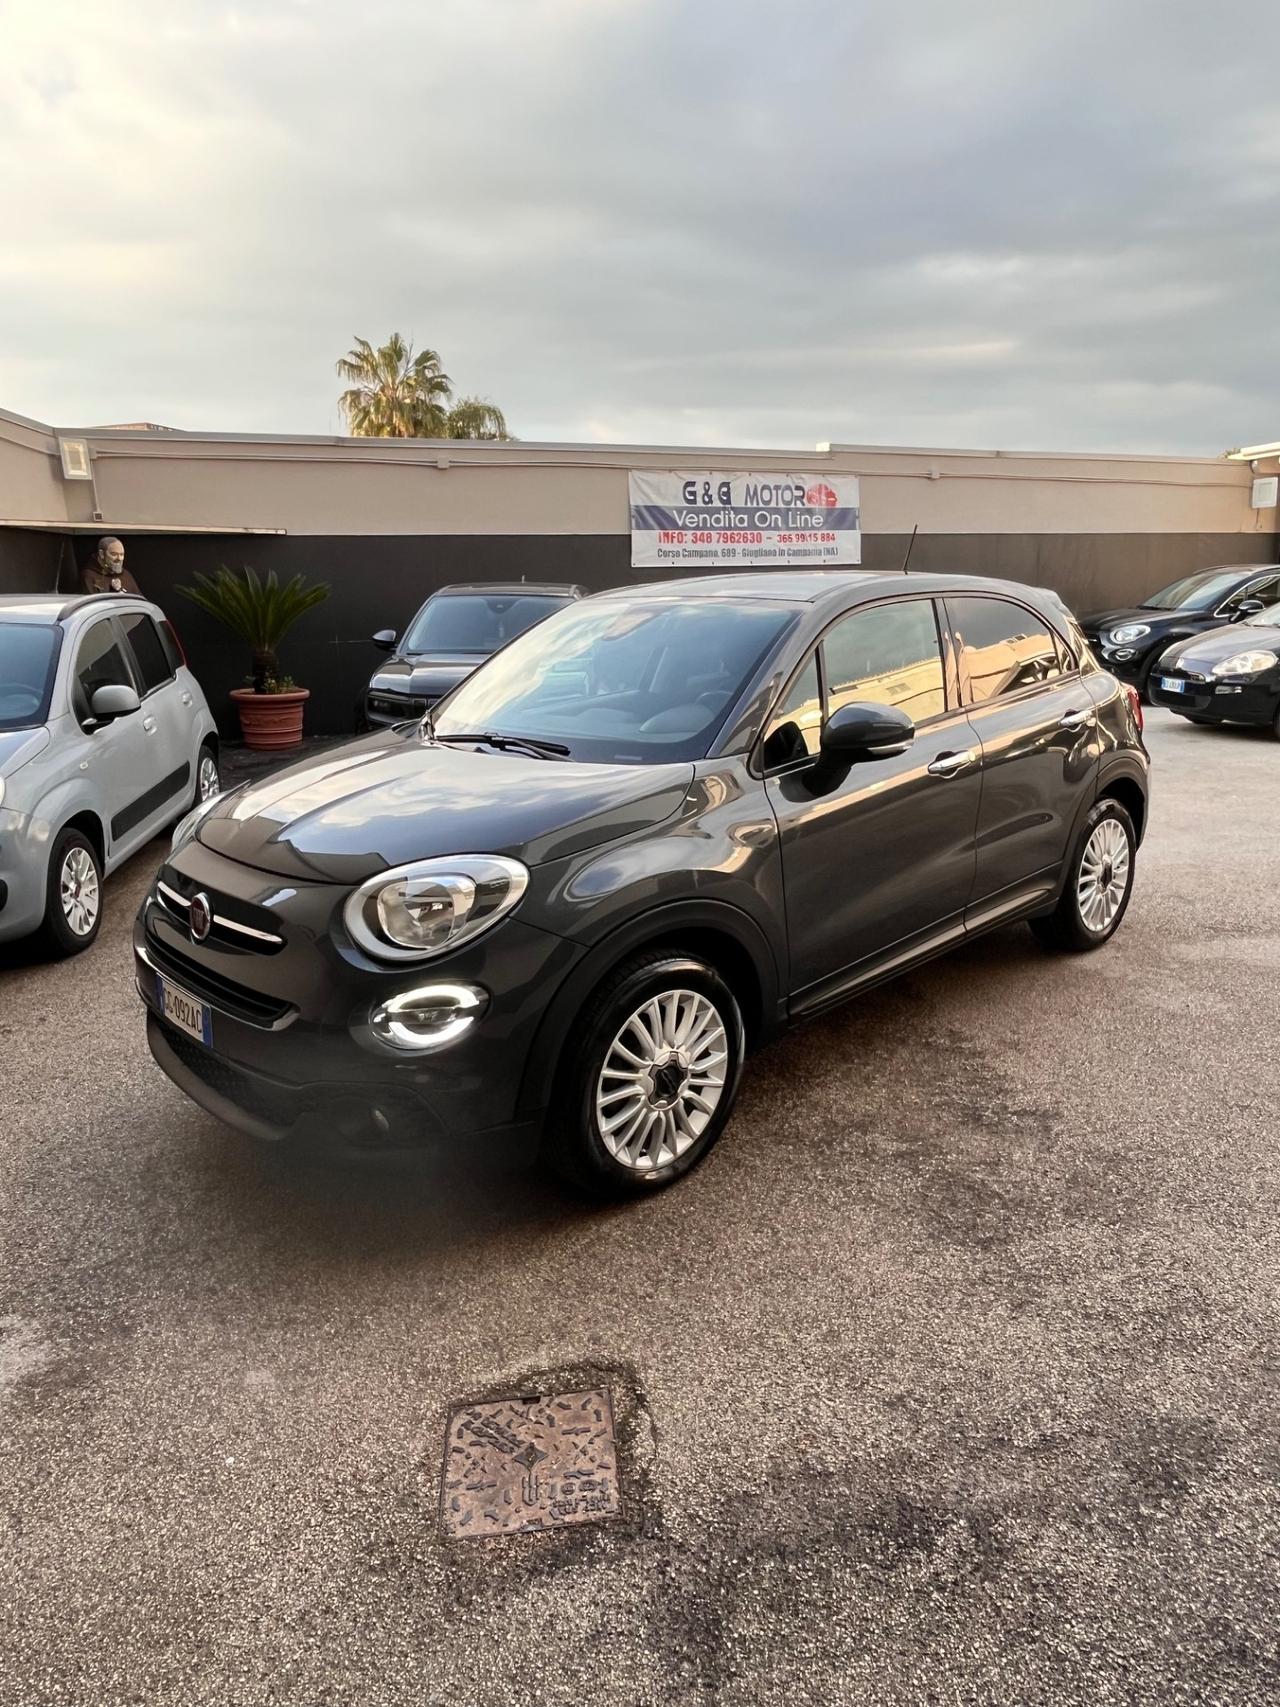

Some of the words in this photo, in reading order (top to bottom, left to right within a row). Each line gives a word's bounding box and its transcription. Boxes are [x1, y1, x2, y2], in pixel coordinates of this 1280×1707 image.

[682, 480, 698, 506] G
[702, 481, 714, 506] &
[673, 510, 748, 528] Vendita
[754, 510, 782, 528] On
[788, 511, 824, 528] Line
[658, 531, 688, 544] INFO:
[691, 532, 713, 544] 348
[716, 532, 762, 544] 7962630
[777, 534, 793, 543] 366
[820, 533, 836, 542] 884
[657, 548, 680, 558] Corso
[721, 548, 736, 558] 689
[741, 548, 777, 558] Giugliano
[778, 547, 786, 557] in
[786, 547, 823, 557] Campania
